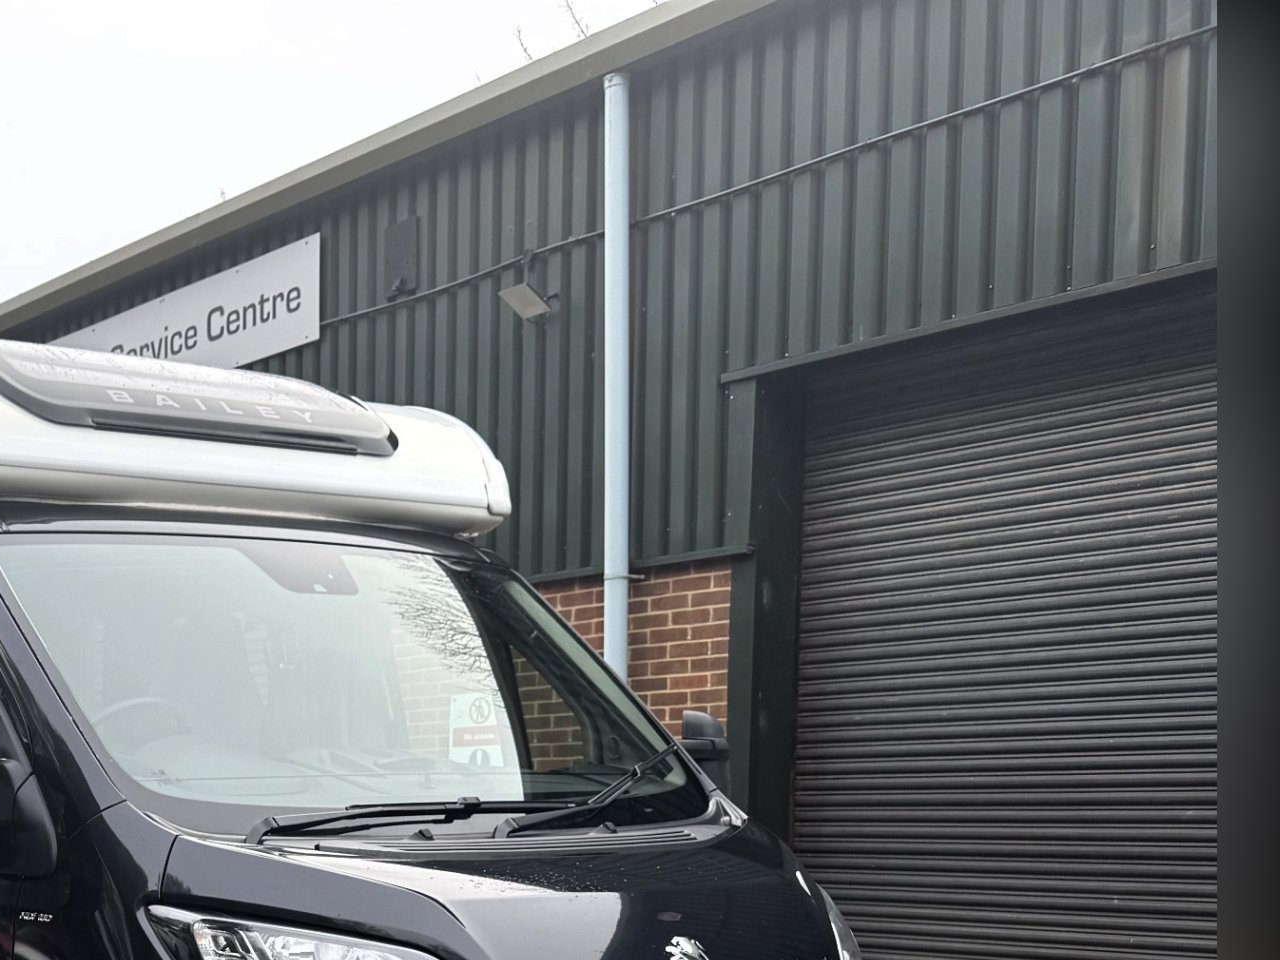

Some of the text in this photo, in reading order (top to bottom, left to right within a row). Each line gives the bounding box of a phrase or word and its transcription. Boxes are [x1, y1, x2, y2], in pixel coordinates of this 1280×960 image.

[110, 286, 302, 358] rvice Centre
[106, 389, 314, 424] BAILEY
